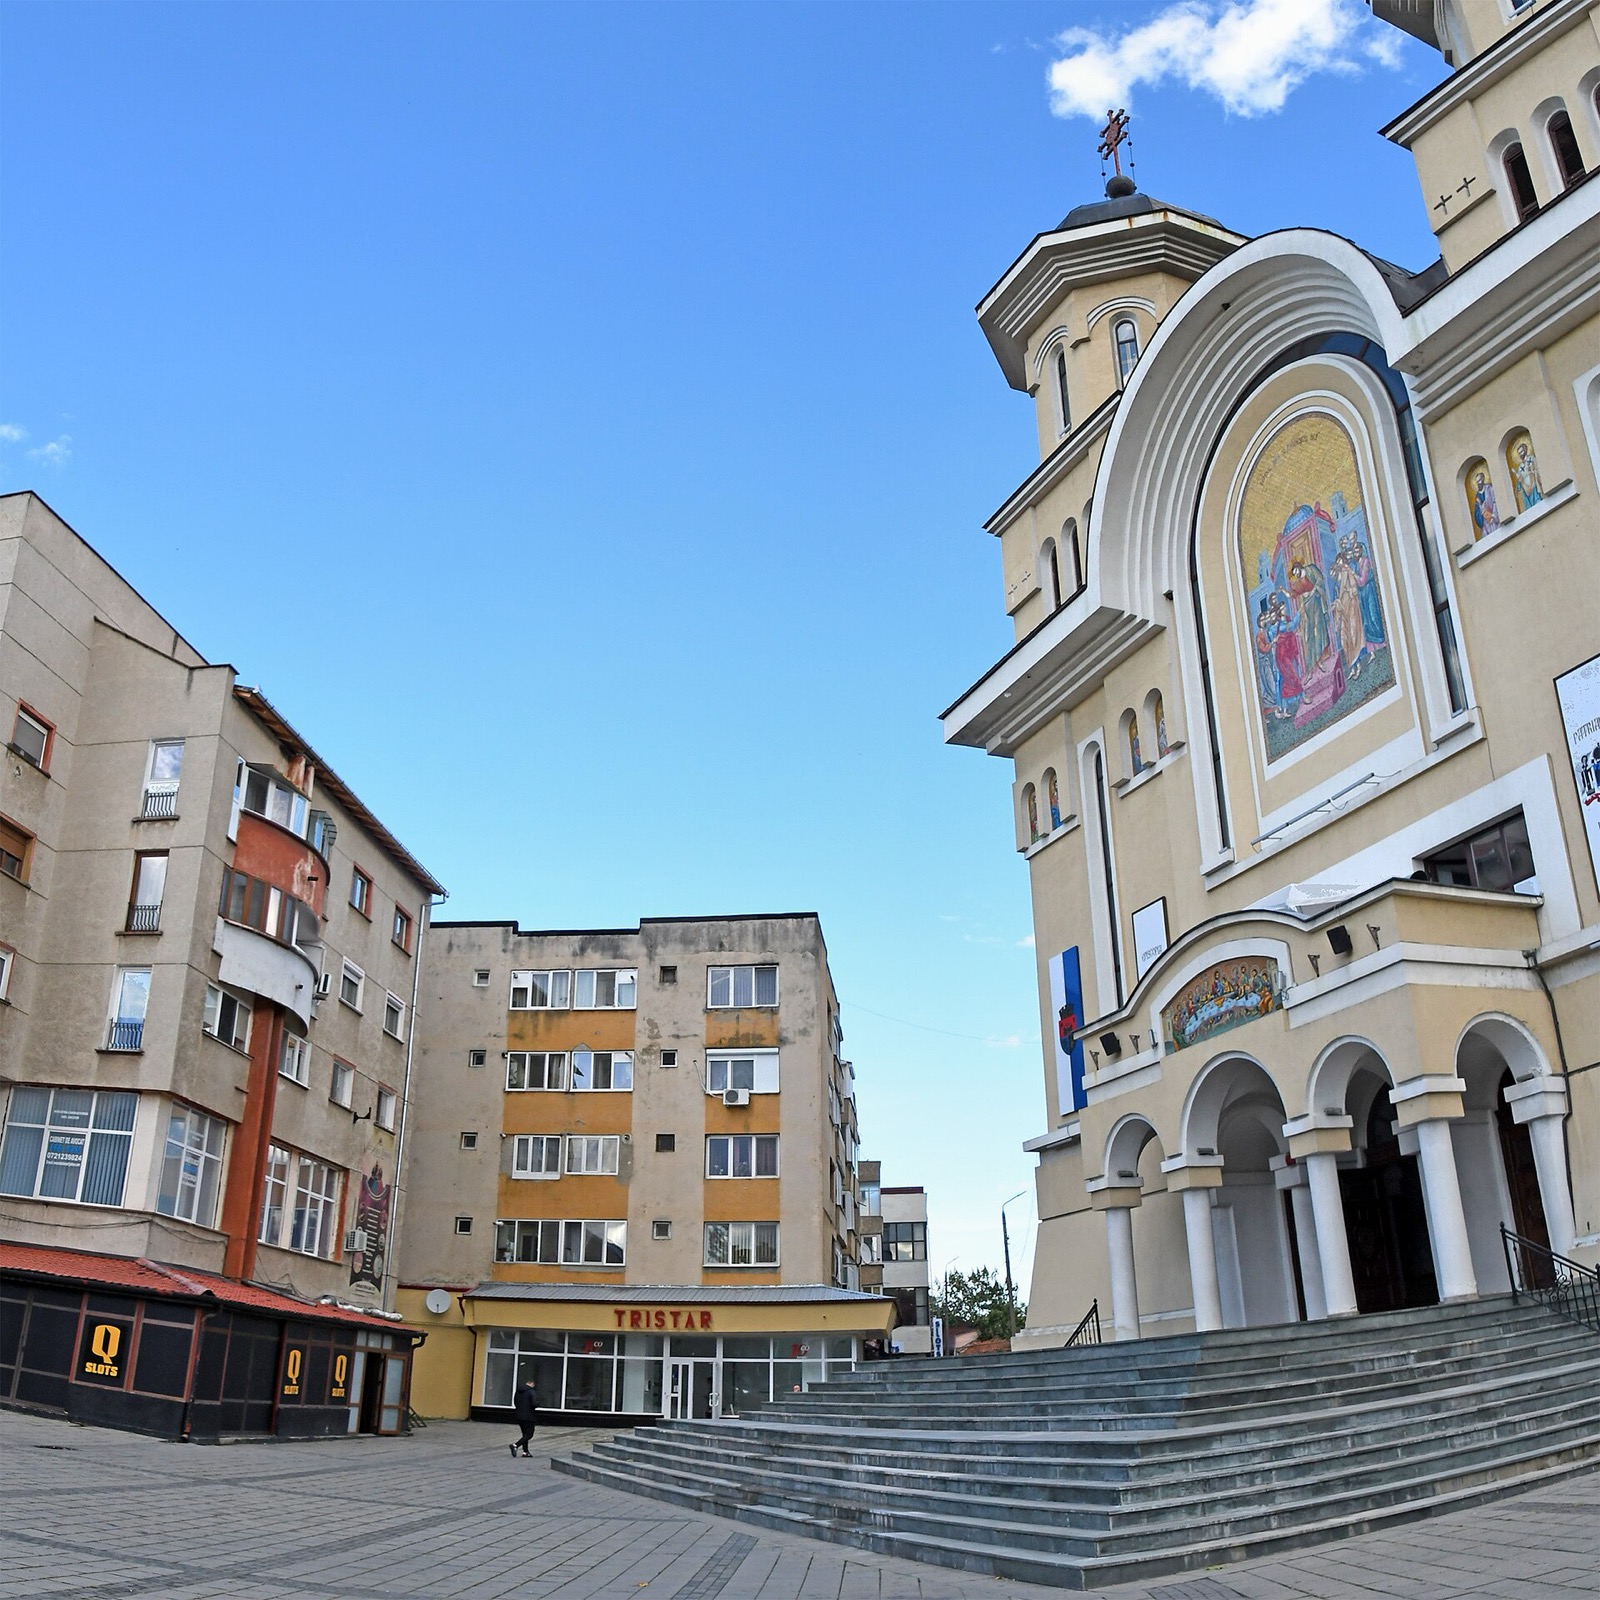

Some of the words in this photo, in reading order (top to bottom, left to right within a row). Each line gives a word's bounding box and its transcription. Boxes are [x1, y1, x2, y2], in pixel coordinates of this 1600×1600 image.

[1572, 716, 1600, 745] PATRIA
[614, 1309, 712, 1329] TRISTAR
[92, 1324, 121, 1365] Q
[85, 1361, 119, 1377] SLOTS
[287, 1349, 302, 1385] Q
[335, 1354, 348, 1388] Q
